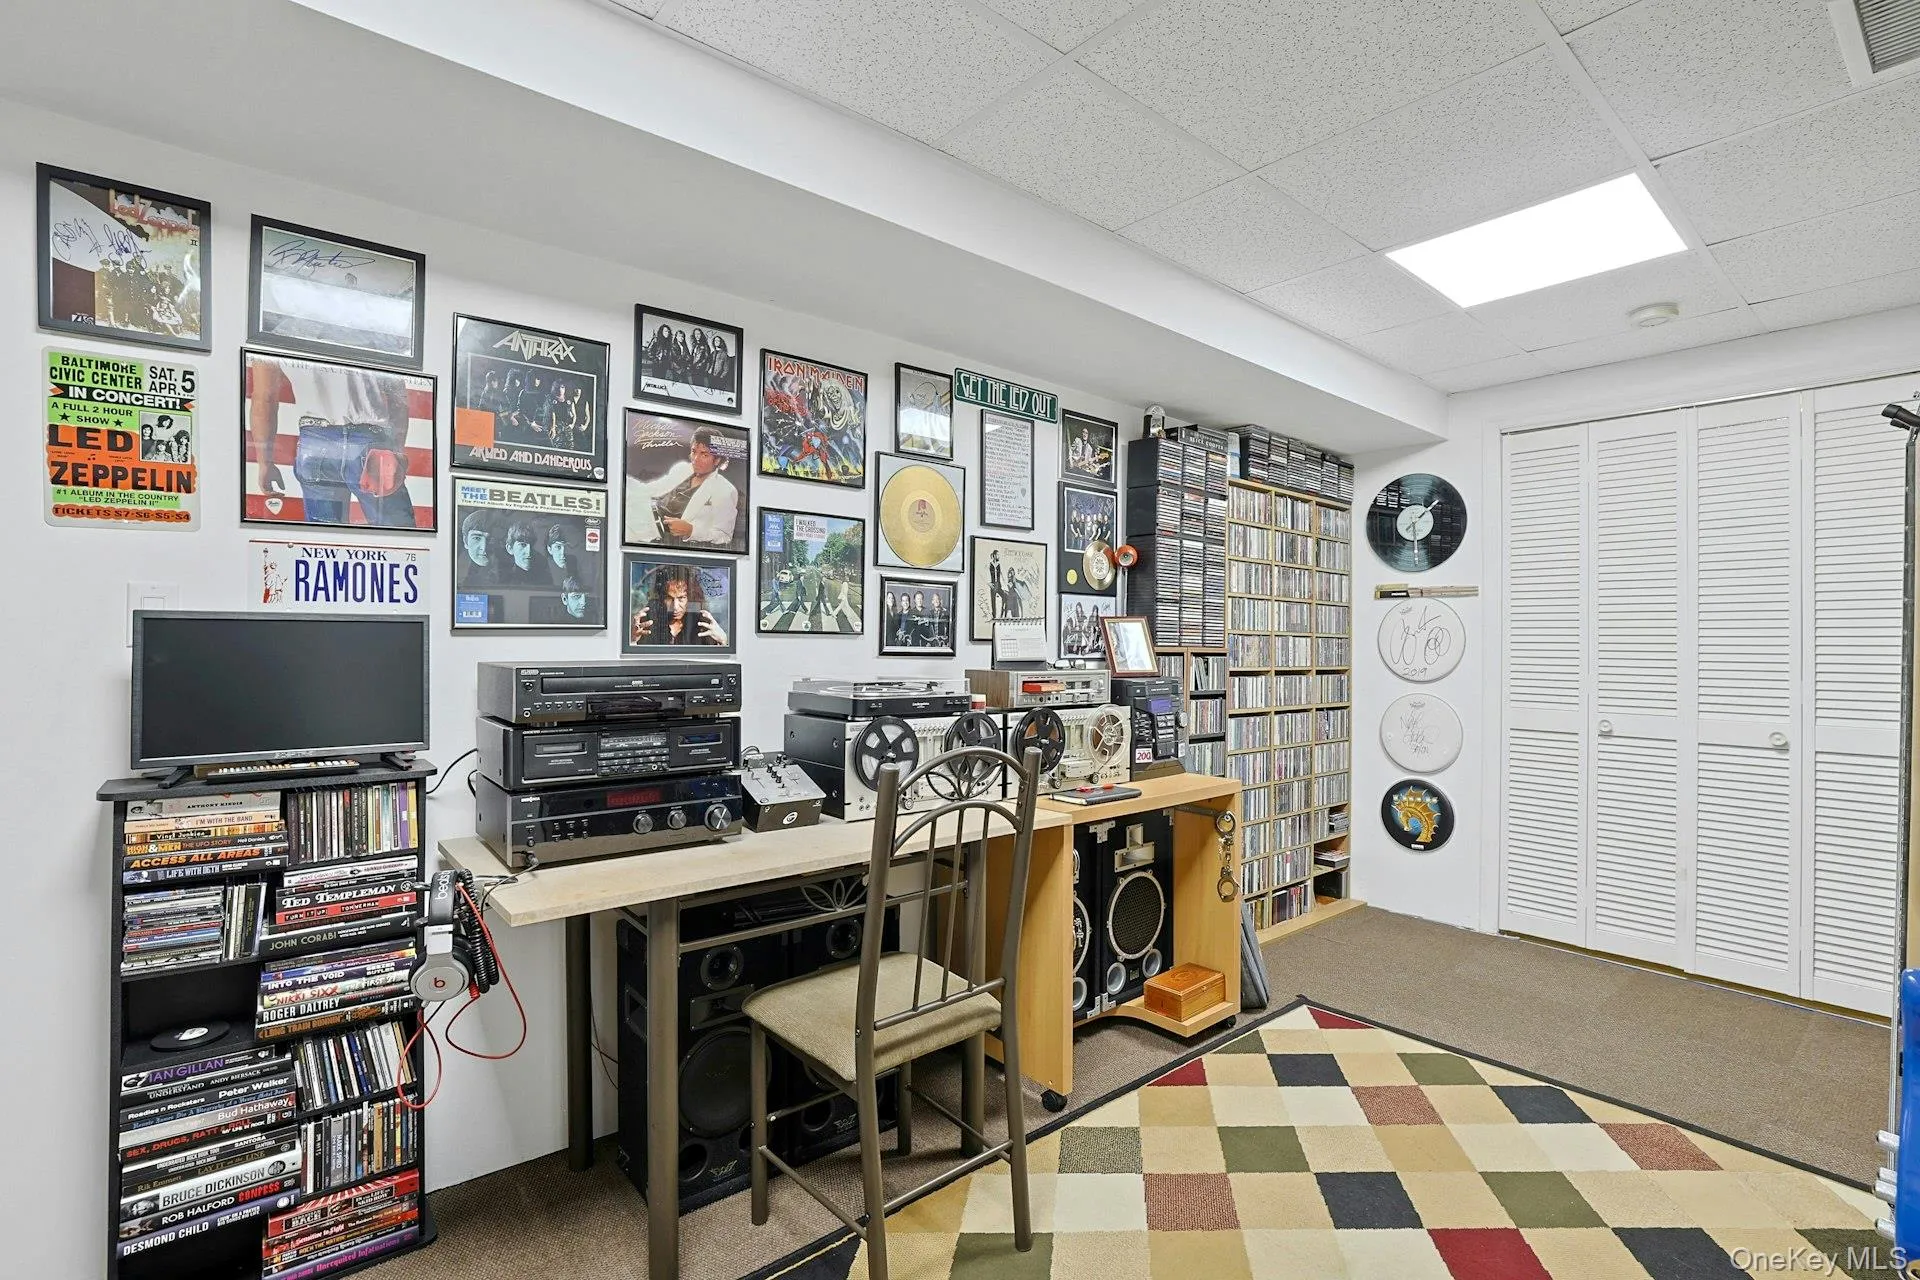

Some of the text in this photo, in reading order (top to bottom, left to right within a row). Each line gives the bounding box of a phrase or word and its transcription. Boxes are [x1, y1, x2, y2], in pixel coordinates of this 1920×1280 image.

[492, 329, 577, 365] ANTHRAX
[61, 355, 137, 375] BALTIMORE
[149, 365, 178, 382] SAT.
[767, 356, 866, 394] IRON MAIDEN
[50, 366, 143, 391] CIVIC CENTER
[149, 382, 181, 396] APR.
[181, 370, 196, 394] 5
[69, 384, 182, 410] IN CONCERT!
[987, 378, 1007, 407] THE
[1009, 386, 1030, 413] LED
[1031, 392, 1053, 419] OUT
[51, 401, 134, 418] A FULL 2 HOUR
[75, 414, 111, 426] SHOW
[48, 423, 134, 453] LED
[469, 446, 592, 473] ARMED AND DANGEROUS
[50, 460, 193, 495] ZEPPELIN
[70, 489, 104, 498] ALBUM
[104, 498, 148, 506] ZEPPELIN
[461, 486, 487, 495] MEET
[462, 487, 601, 511] THE BEATLES!
[54, 504, 111, 517] TICKETS
[300, 547, 388, 561] NEW YORK
[405, 552, 417, 562] 76
[295, 559, 418, 604] RAMONES
[156, 831, 176, 840] Vinyl
[130, 848, 261, 869] ACCESS ALL AREAS
[166, 869, 185, 879] LIFE
[281, 895, 311, 910] TED
[315, 883, 397, 905] TEMPLEMAN
[284, 912, 305, 922] TURN
[269, 939, 299, 952] JOHN
[301, 931, 338, 946] CORABI
[267, 970, 346, 991] INTO THE VOID
[276, 993, 306, 1006] NIKKI
[310, 985, 339, 999] SIXX
[262, 998, 341, 1023] ROGER DALTREY
[287, 1020, 311, 1032] TRAIN
[148, 1058, 226, 1084] IAN GILLAN
[149, 1082, 205, 1099] UNDERSTAND
[210, 1077, 229, 1086] ANDY
[218, 1076, 291, 1099] Peter Walker
[127, 1108, 160, 1120] Roadies
[167, 1097, 206, 1111] Rocksters
[218, 1096, 290, 1121] Bud Hathaway
[127, 1146, 150, 1159] SEX,
[152, 1137, 190, 1152] DRUGS,
[192, 1128, 220, 1141] RATT
[137, 1182, 153, 1193] Rik
[155, 1175, 183, 1189] Emmett
[246, 1151, 266, 1162] LINE
[162, 1167, 266, 1208] BRUCE DICKINSON
[161, 1210, 185, 1226] ROB
[186, 1195, 236, 1218] HALFORD
[123, 1235, 177, 1257] DESMOND
[178, 1220, 210, 1240] CHILD
[316, 1251, 357, 1272] Unrequited
